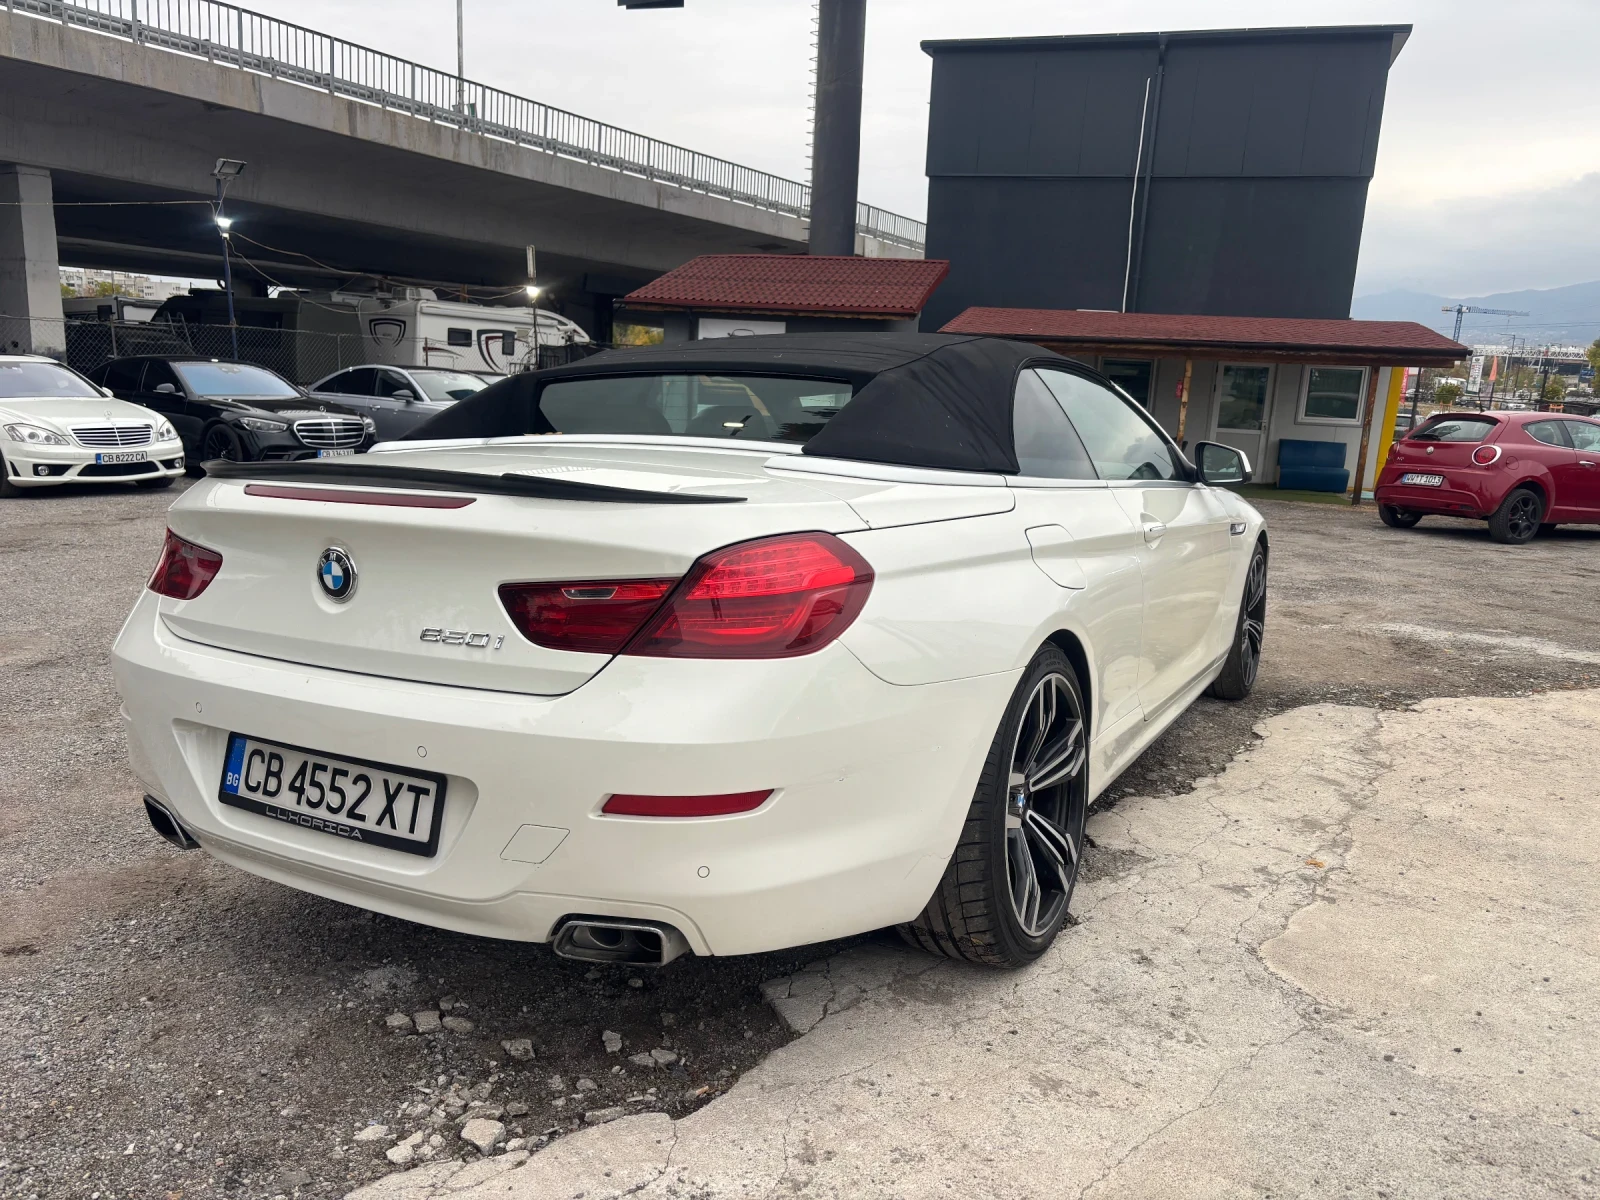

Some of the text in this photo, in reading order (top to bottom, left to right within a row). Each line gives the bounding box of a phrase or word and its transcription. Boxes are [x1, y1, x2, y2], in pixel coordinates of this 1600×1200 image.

[226, 772, 239, 787] BG
[244, 748, 431, 835] CB 4552 XT
[265, 806, 363, 840] LUXORICA
